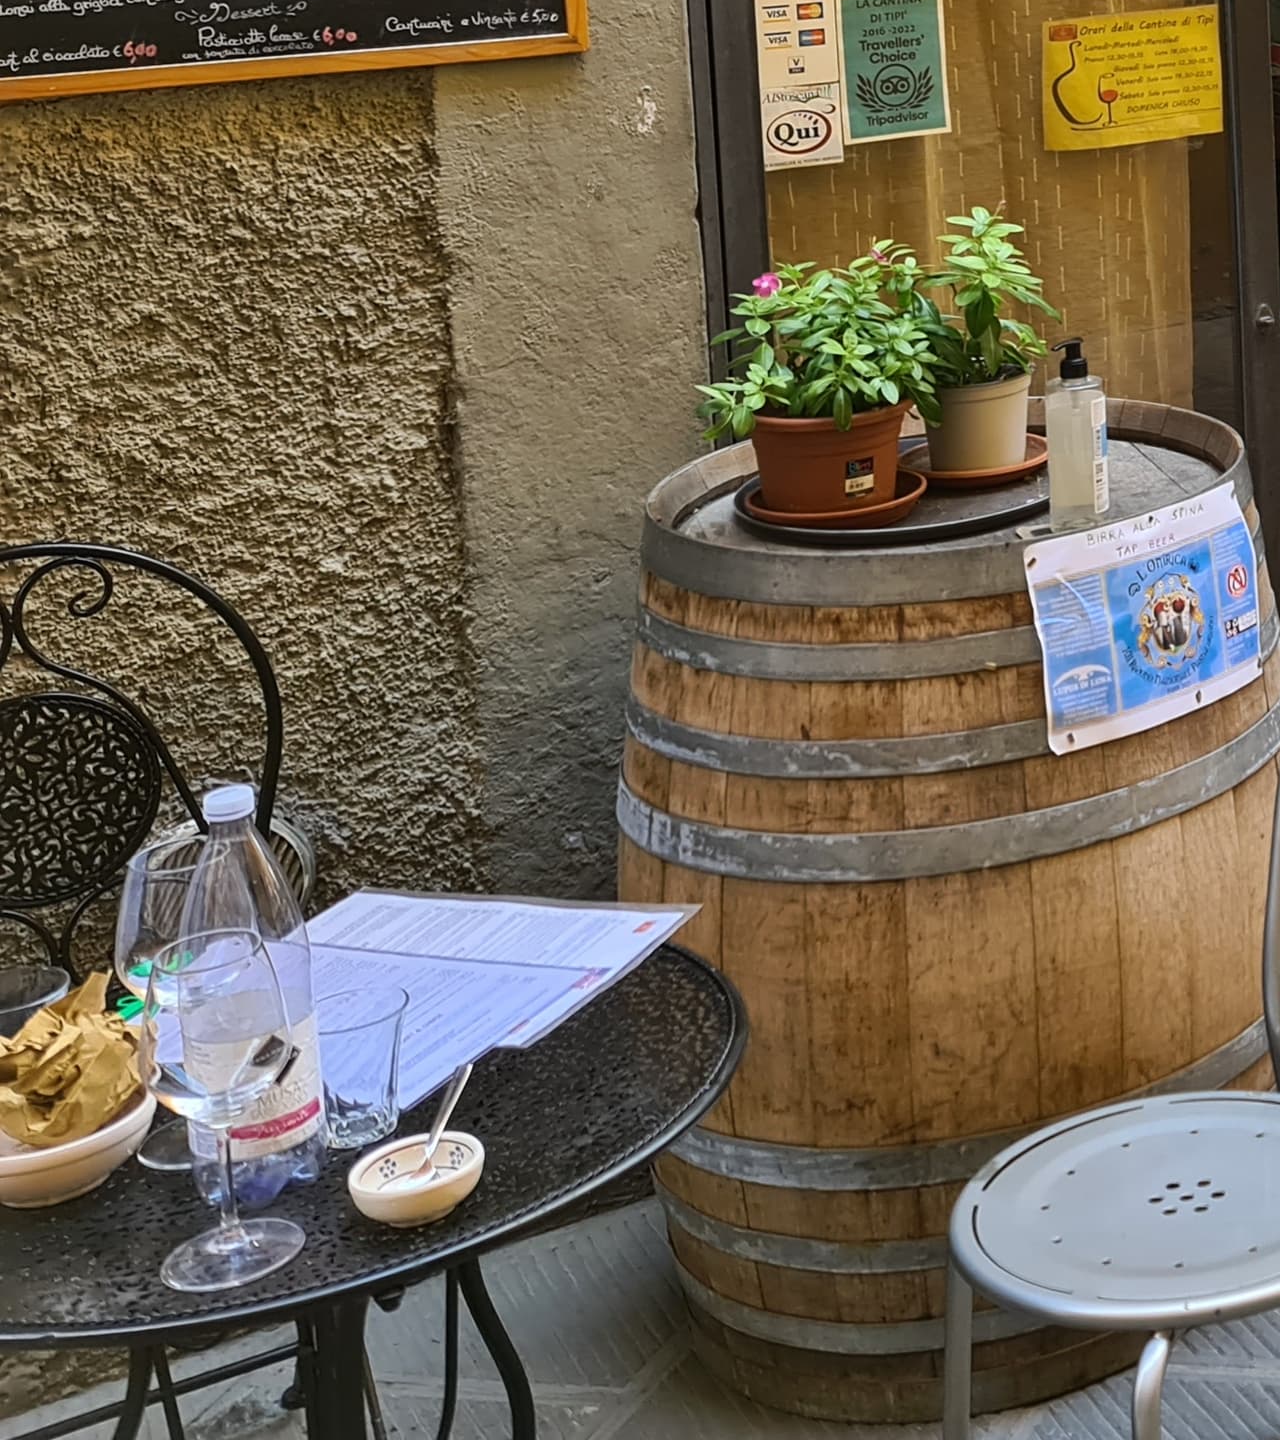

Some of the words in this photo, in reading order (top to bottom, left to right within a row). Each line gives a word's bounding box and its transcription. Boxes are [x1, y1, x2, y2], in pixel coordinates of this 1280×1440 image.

[200, 1, 282, 23] Dessert
[856, 0, 870, 9] LA
[766, 9, 787, 18] VISA
[870, 13, 881, 23] DI
[1079, 24, 1106, 36] Orari
[1111, 21, 1134, 33] della
[1139, 19, 1177, 30] Cantina
[1182, 16, 1192, 26] di
[769, 36, 788, 45] VISA
[859, 34, 925, 51] Travellers'
[869, 50, 916, 64] Choice
[866, 110, 929, 126] Tripadvisor
[1086, 528, 1125, 546] BIRRA
[1171, 504, 1204, 522] SPINA
[1116, 543, 1138, 558] TAP
